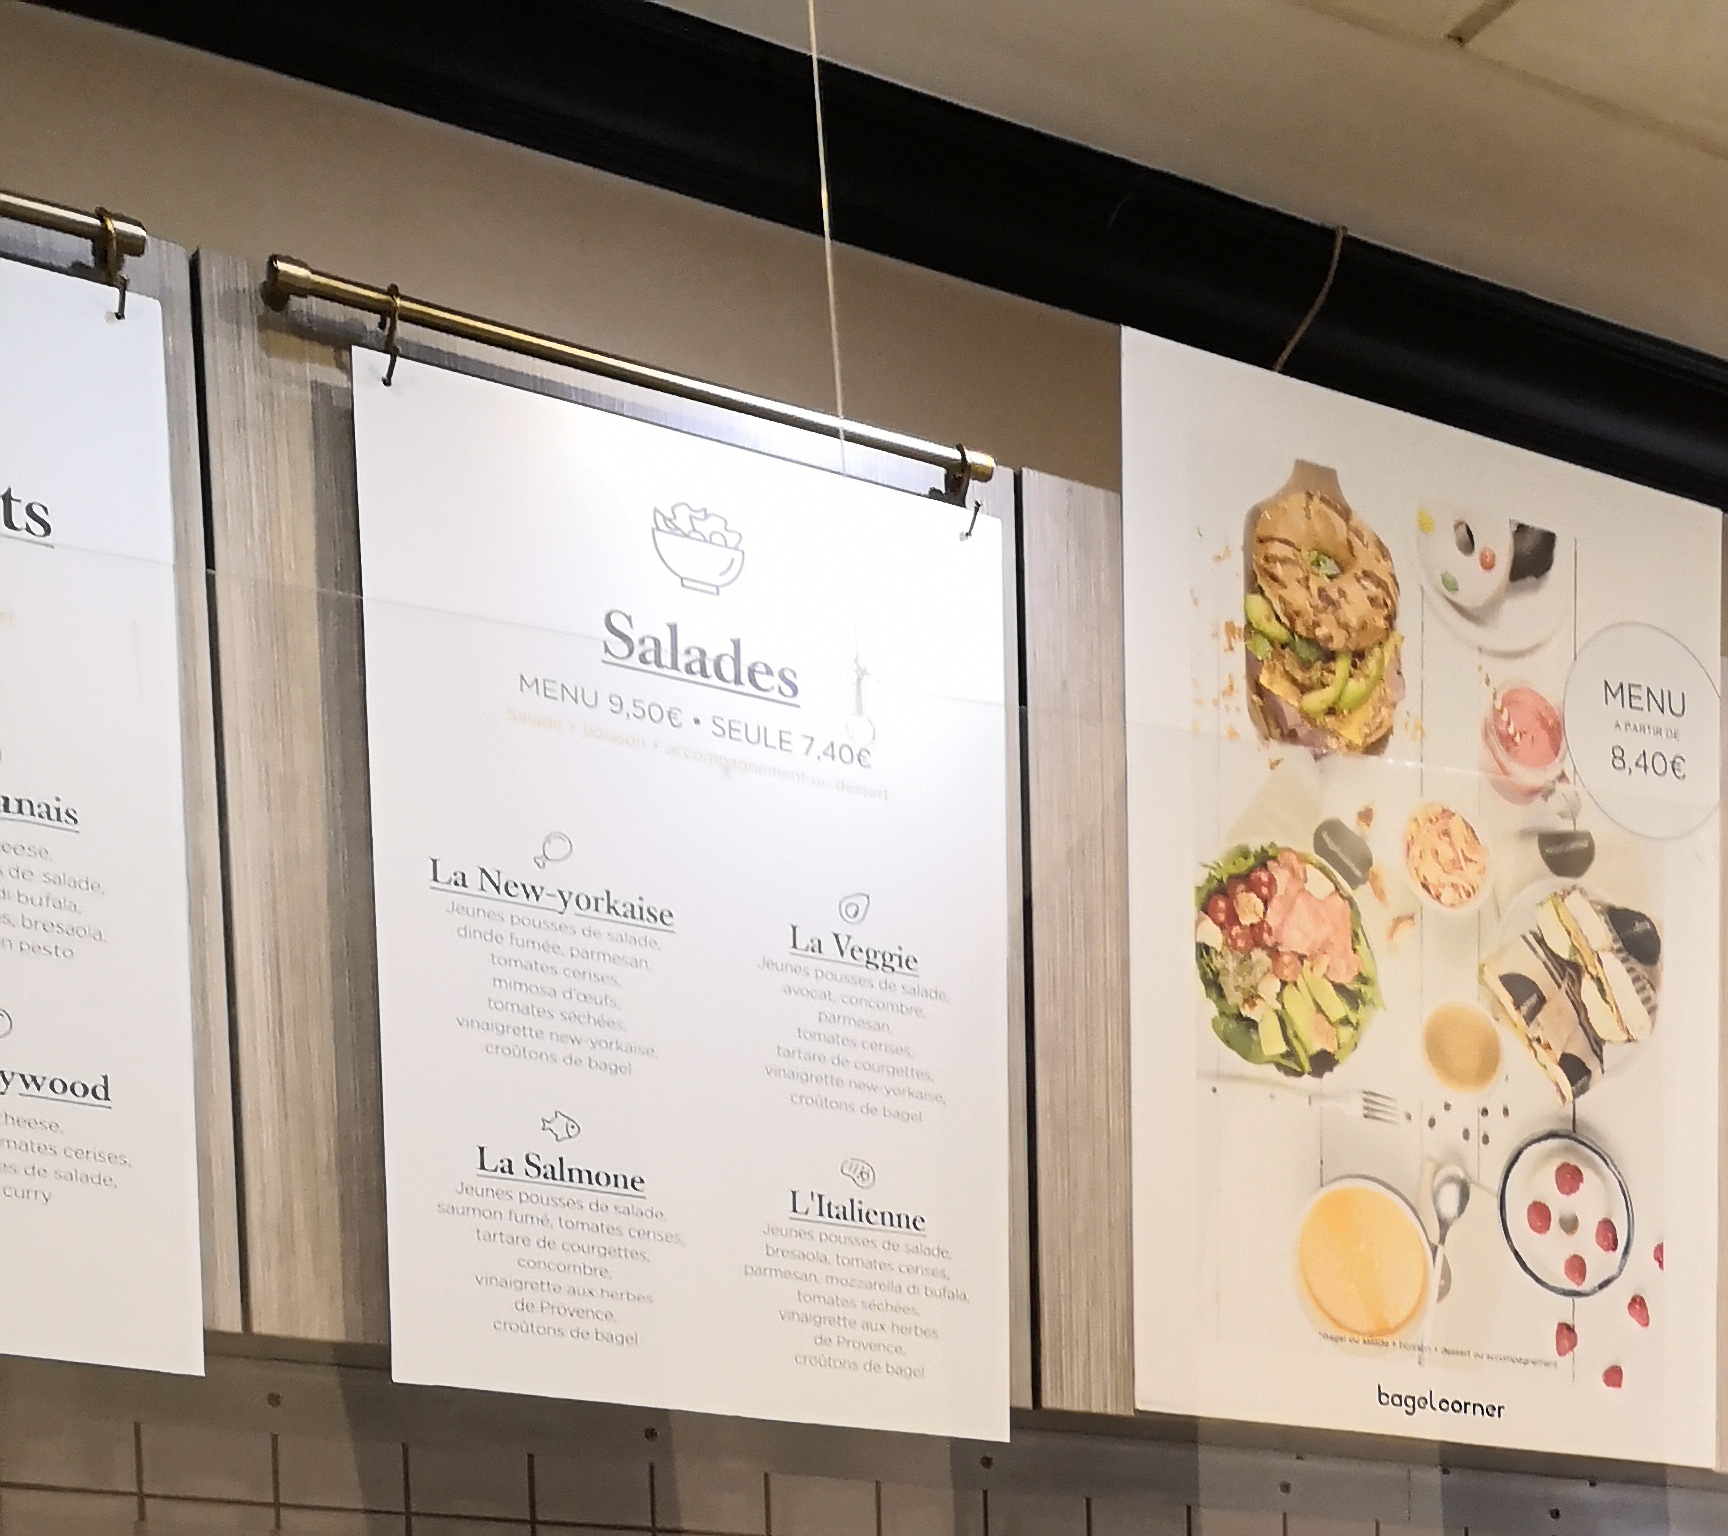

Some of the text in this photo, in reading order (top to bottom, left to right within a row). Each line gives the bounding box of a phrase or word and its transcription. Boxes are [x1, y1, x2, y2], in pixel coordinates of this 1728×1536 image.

[603, 607, 800, 700] Salades
[519, 673, 600, 709] MENU
[608, 695, 684, 730] 9,50€
[711, 715, 794, 753] SEULE
[1603, 679, 1687, 718] MENU
[1611, 744, 1687, 782] 8,40€
[429, 856, 676, 928] La New-yorkaise
[789, 923, 919, 973] La Veggie
[477, 1145, 647, 1193] La Salmone
[789, 1188, 927, 1232] L'Italienne
